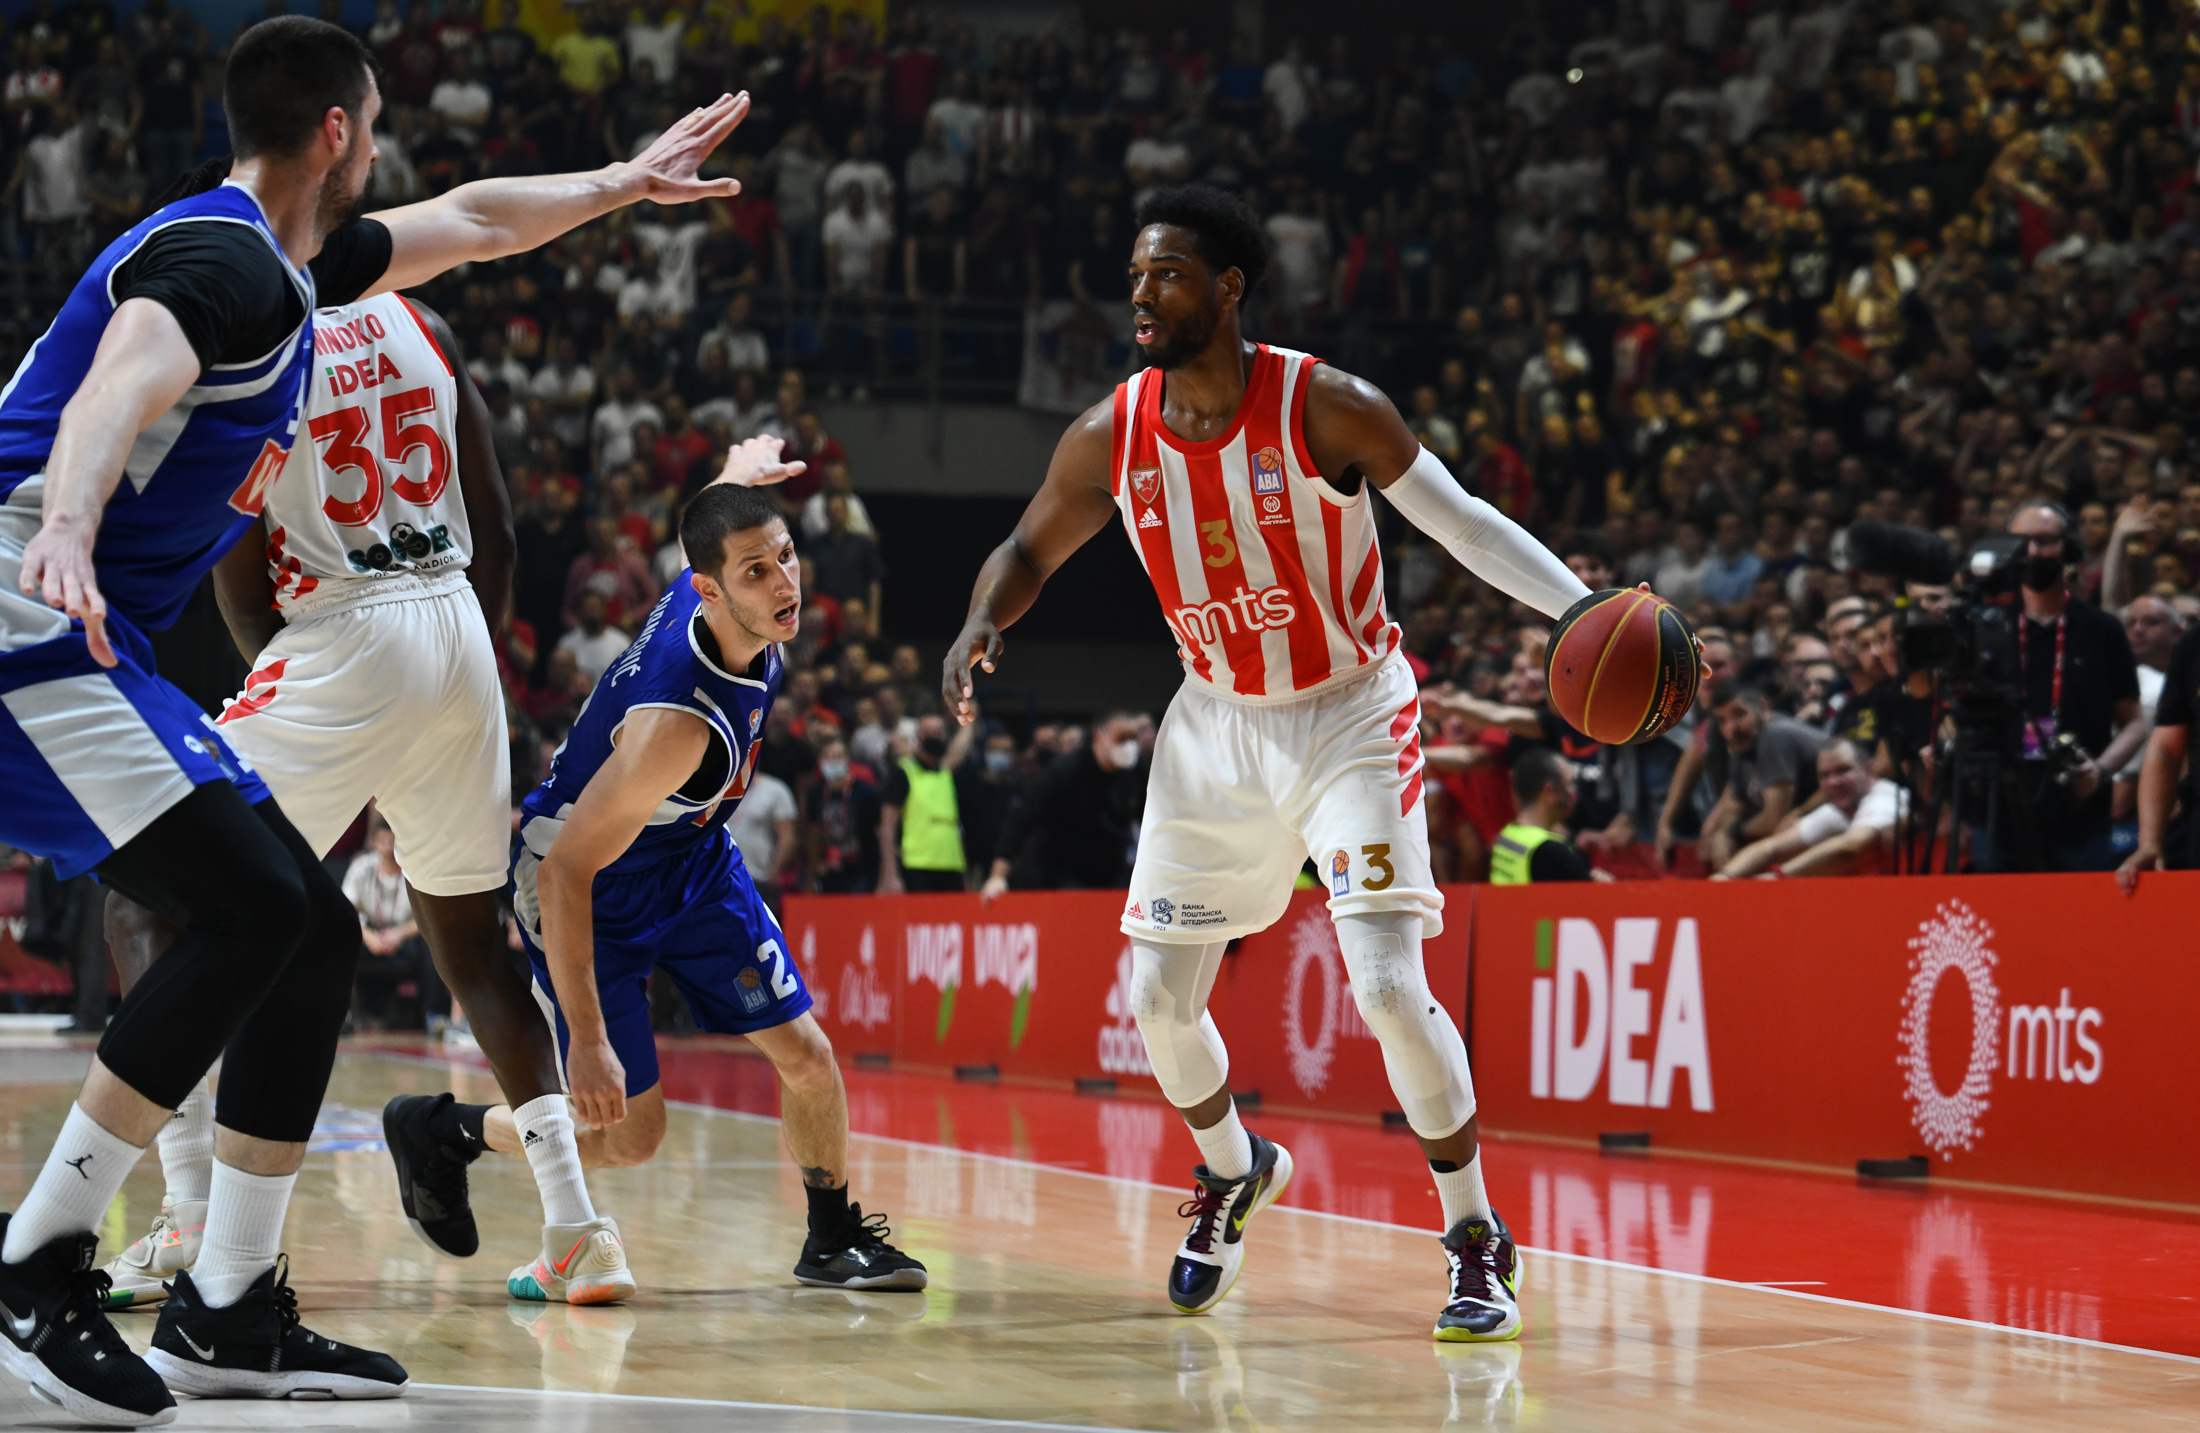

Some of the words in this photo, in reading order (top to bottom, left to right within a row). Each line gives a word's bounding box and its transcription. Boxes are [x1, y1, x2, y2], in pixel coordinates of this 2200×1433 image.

[307, 386, 451, 527] 35
[1258, 473, 1280, 491] ABA
[1138, 520, 1163, 529] adidas
[1200, 519, 1236, 568] 3
[1174, 586, 1296, 643] mts
[1361, 843, 1395, 891] 3
[1335, 875, 1348, 894] ABA
[1127, 909, 1145, 920] adidas
[1181, 910, 1222, 918] ПОШТАНСКА
[1181, 916, 1228, 926] ШТЕДИОНИЦА
[757, 938, 798, 1000] 2
[744, 990, 767, 1010] ABA
[2008, 986, 2104, 1085] mts
